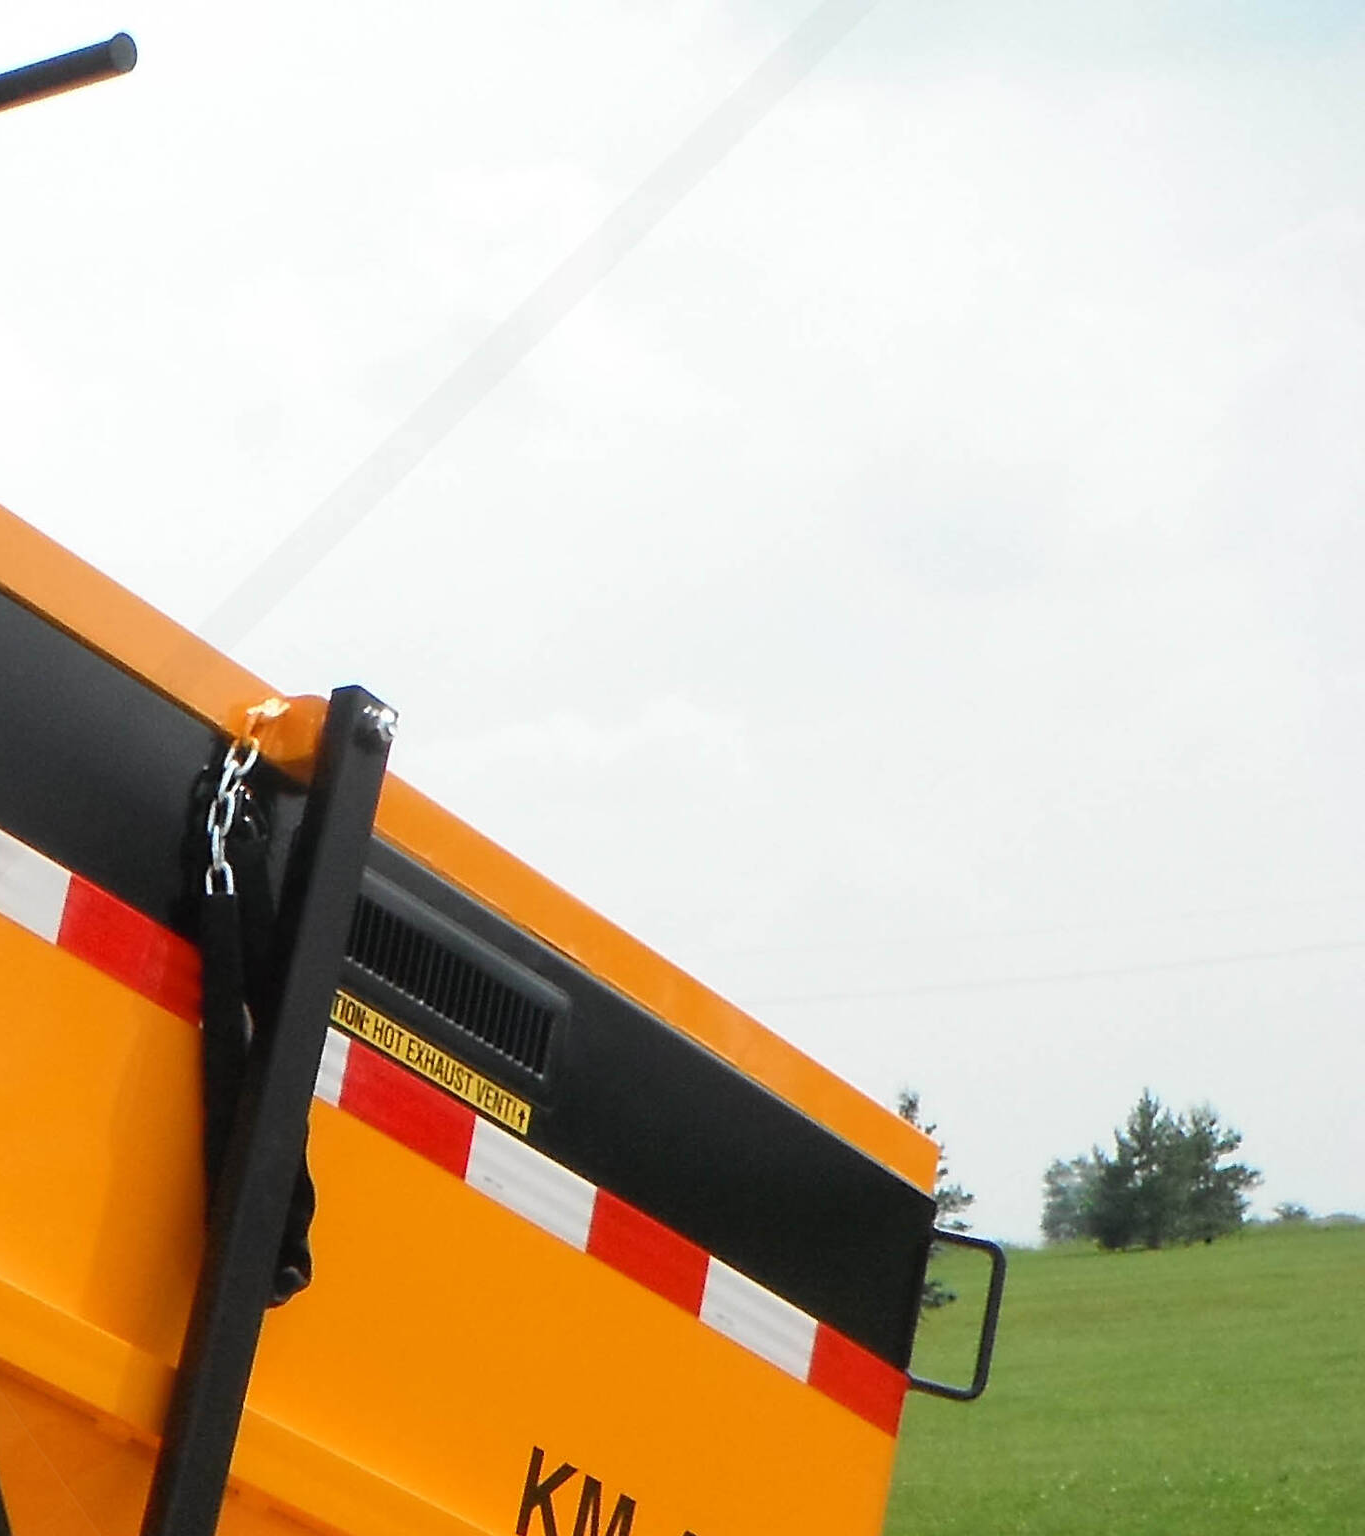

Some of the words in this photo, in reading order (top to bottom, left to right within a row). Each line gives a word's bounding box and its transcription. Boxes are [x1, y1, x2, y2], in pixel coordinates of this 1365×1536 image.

[372, 1017, 402, 1055] HOT
[406, 1037, 473, 1096] EXHAUST
[475, 1076, 518, 1123] VENT!
